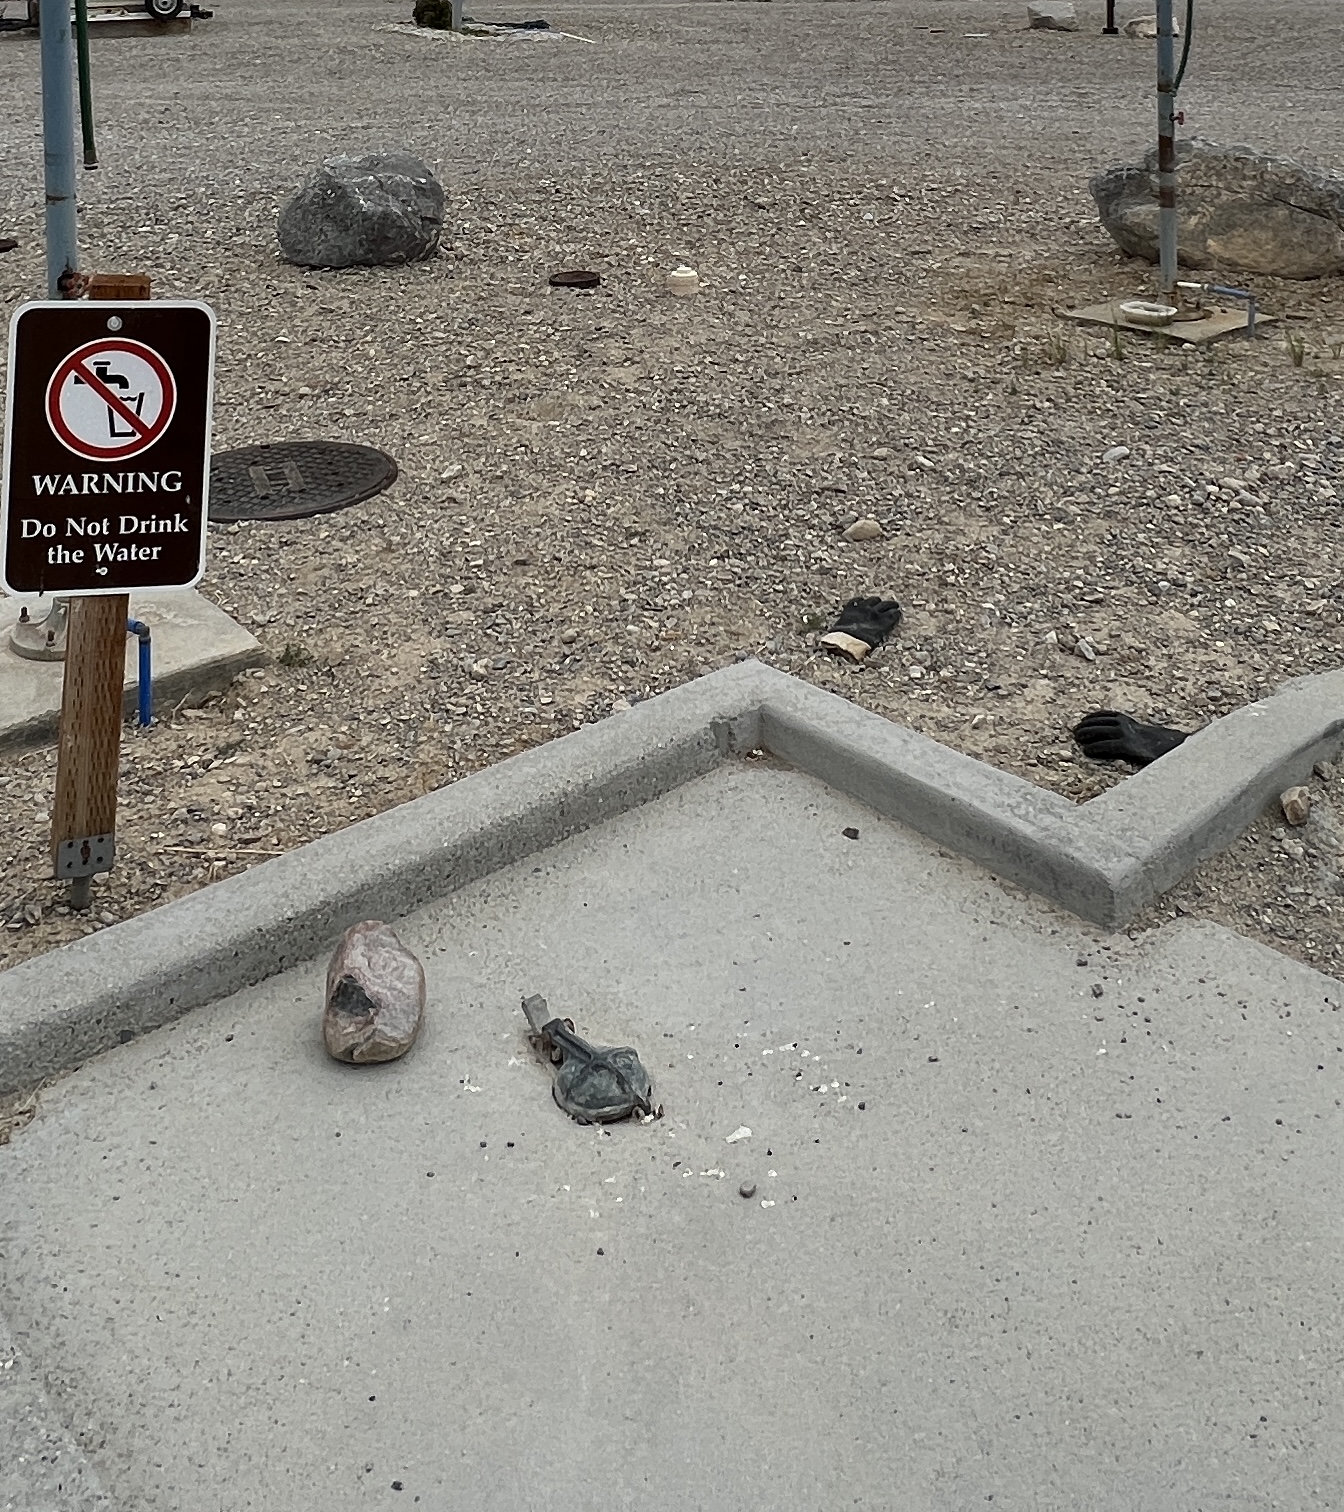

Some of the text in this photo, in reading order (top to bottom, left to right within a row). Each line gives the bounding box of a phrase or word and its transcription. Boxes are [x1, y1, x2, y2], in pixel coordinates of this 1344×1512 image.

[32, 470, 183, 496] WARNING
[21, 513, 189, 538] Do Not Drink
[47, 543, 162, 564] the Water
